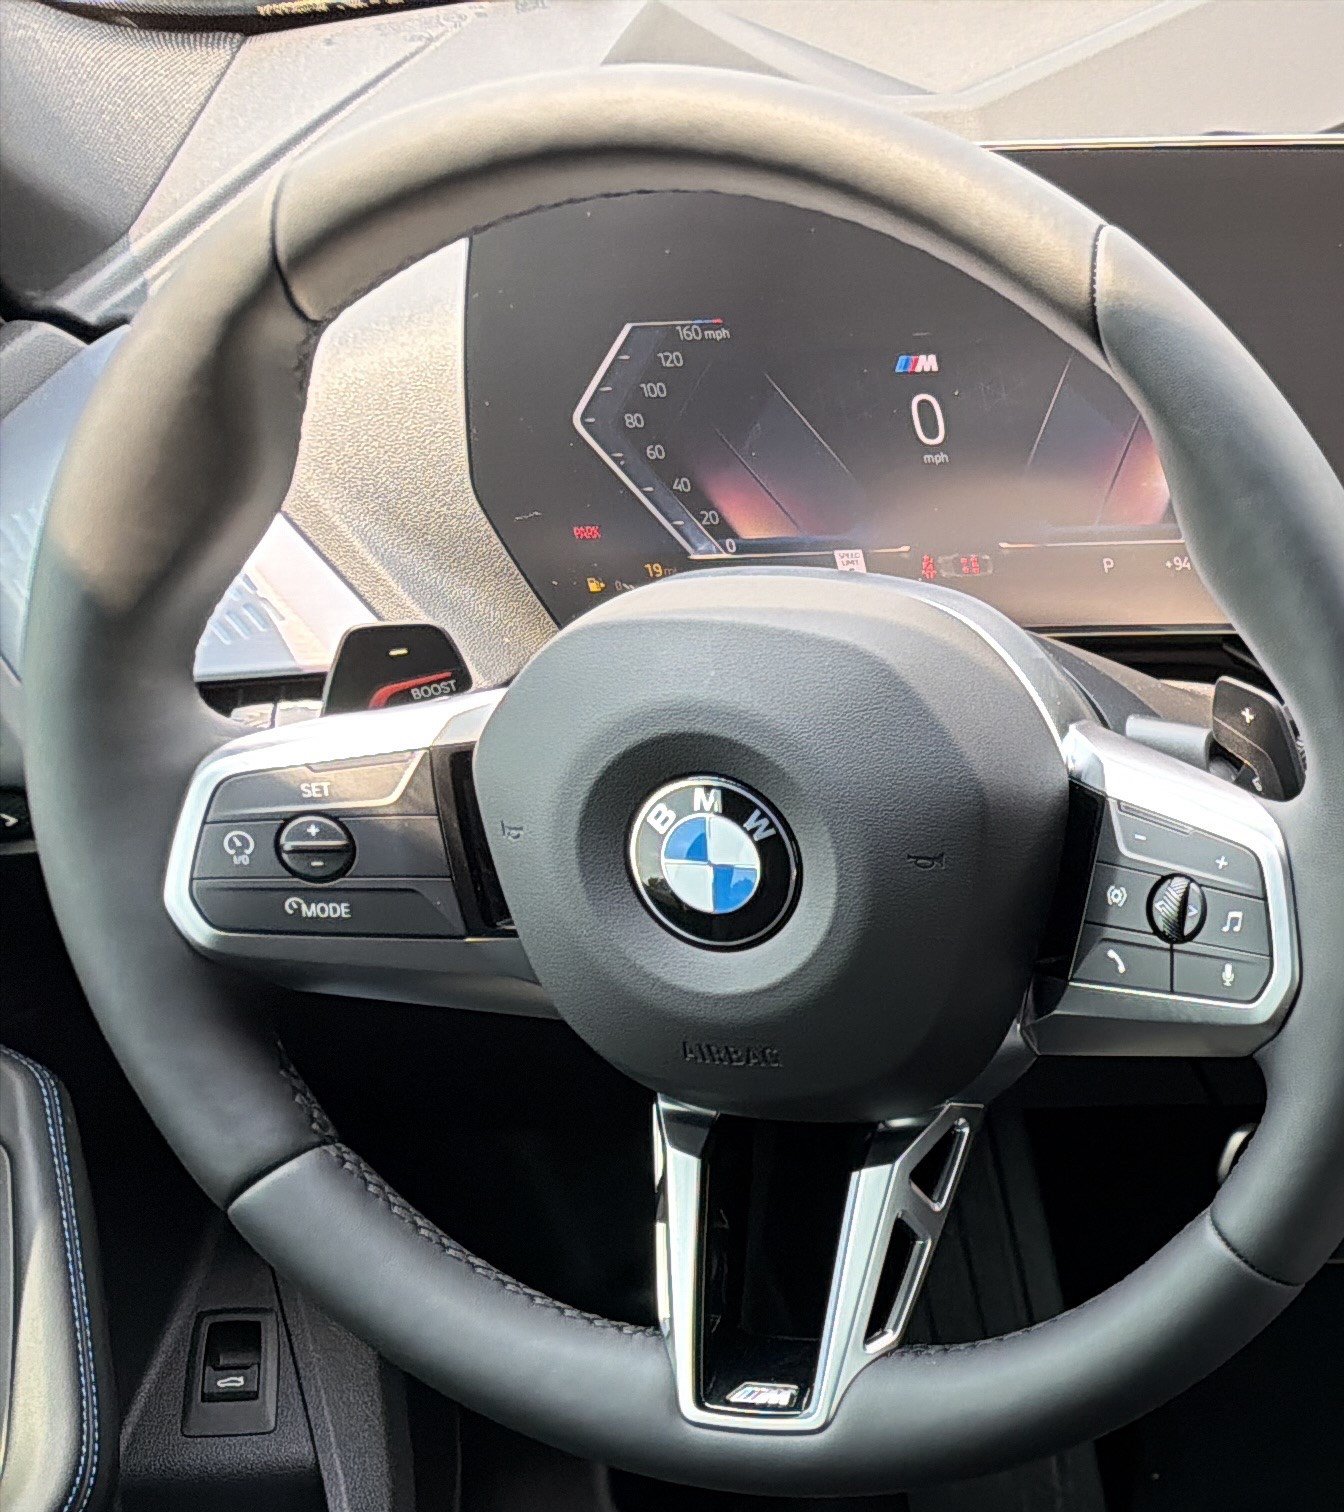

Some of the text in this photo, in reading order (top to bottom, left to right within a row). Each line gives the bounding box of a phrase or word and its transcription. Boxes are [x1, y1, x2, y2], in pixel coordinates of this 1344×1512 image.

[675, 324, 731, 342] 160 mph
[656, 351, 684, 367] 120
[639, 382, 667, 398] 100
[624, 413, 645, 429] 80
[911, 393, 946, 446] 0
[646, 444, 666, 460] 60
[923, 451, 950, 465] mph
[672, 477, 691, 493] 40
[700, 510, 720, 525] 20
[725, 538, 737, 553] 0
[643, 562, 664, 578] 19
[410, 679, 457, 700] BOOST
[300, 781, 331, 799] SET
[646, 787, 777, 843] BMW
[300, 903, 352, 919] MODE
